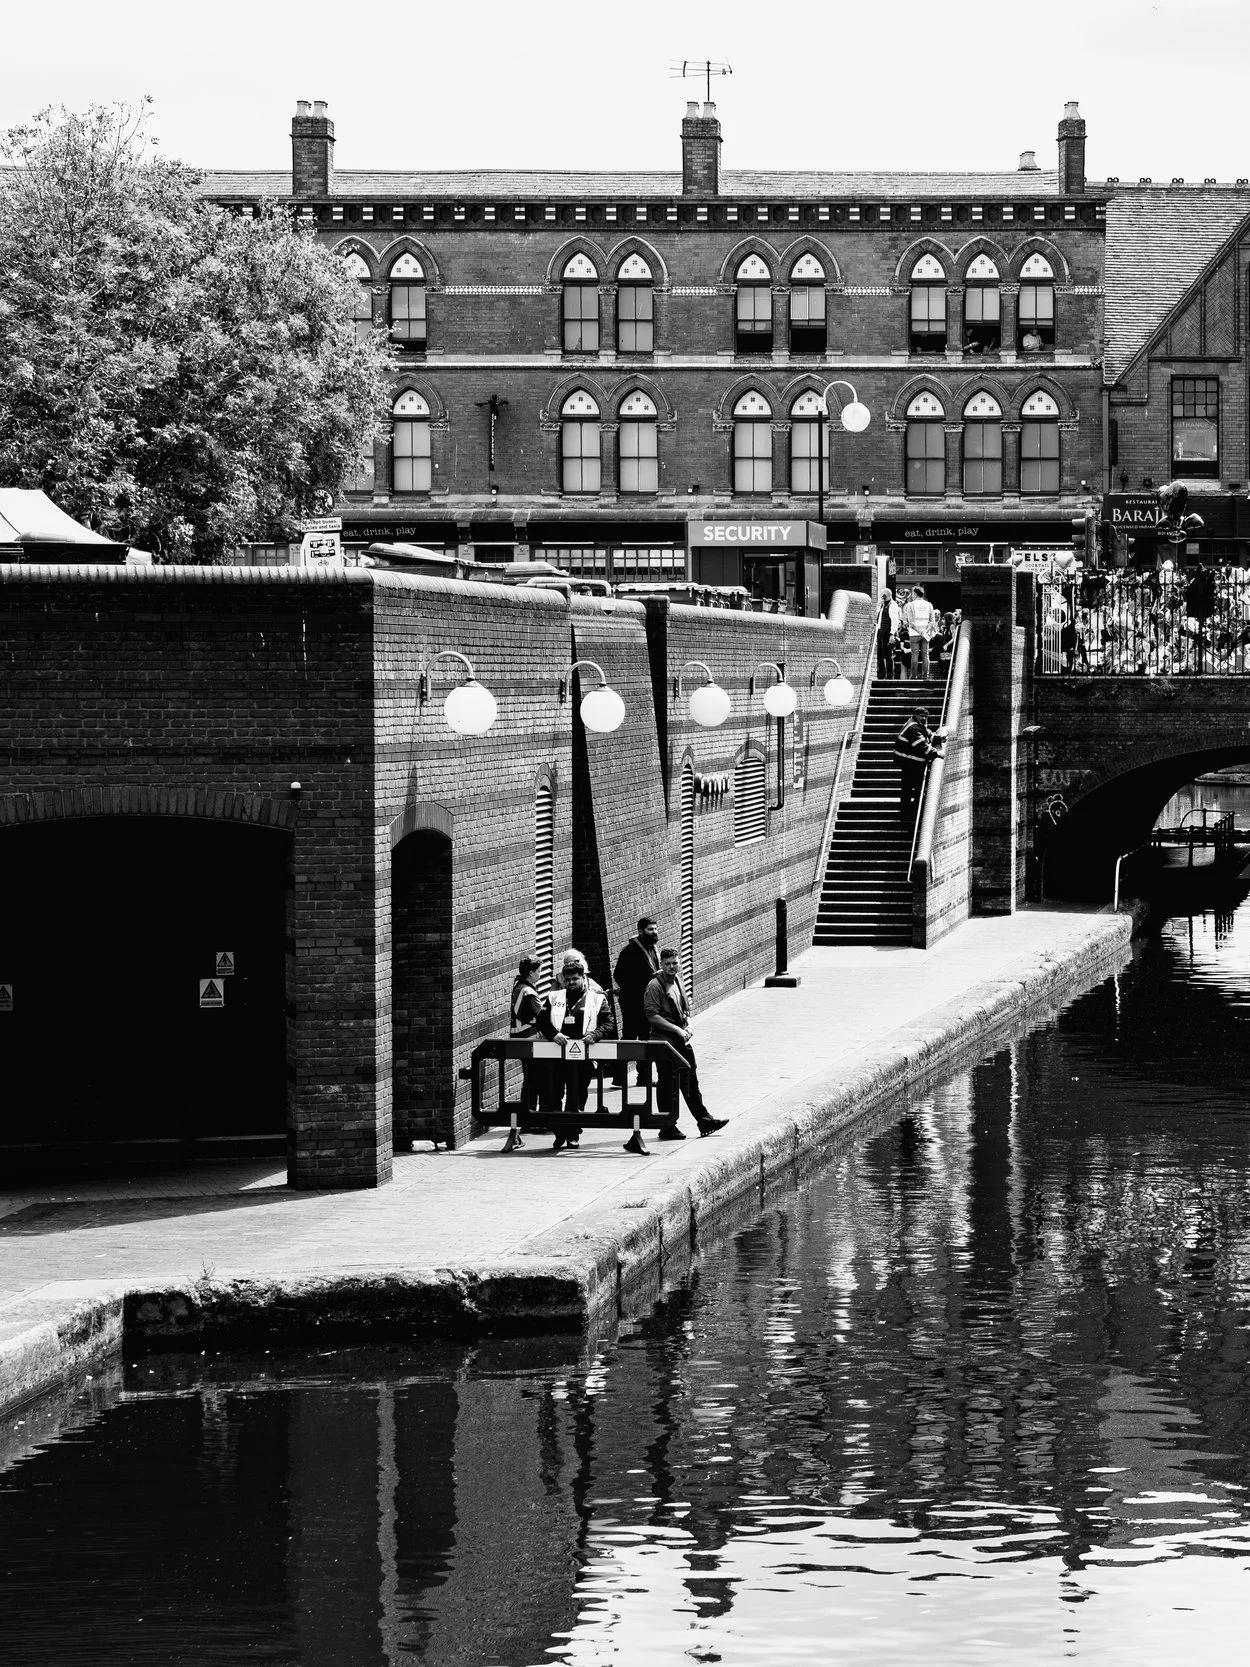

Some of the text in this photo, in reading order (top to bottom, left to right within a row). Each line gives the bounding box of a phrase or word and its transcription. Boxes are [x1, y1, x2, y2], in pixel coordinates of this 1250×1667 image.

[343, 527, 417, 537] eat, drink, play
[703, 525, 792, 542] SECURITY
[904, 526, 979, 538] eat, drink, play
